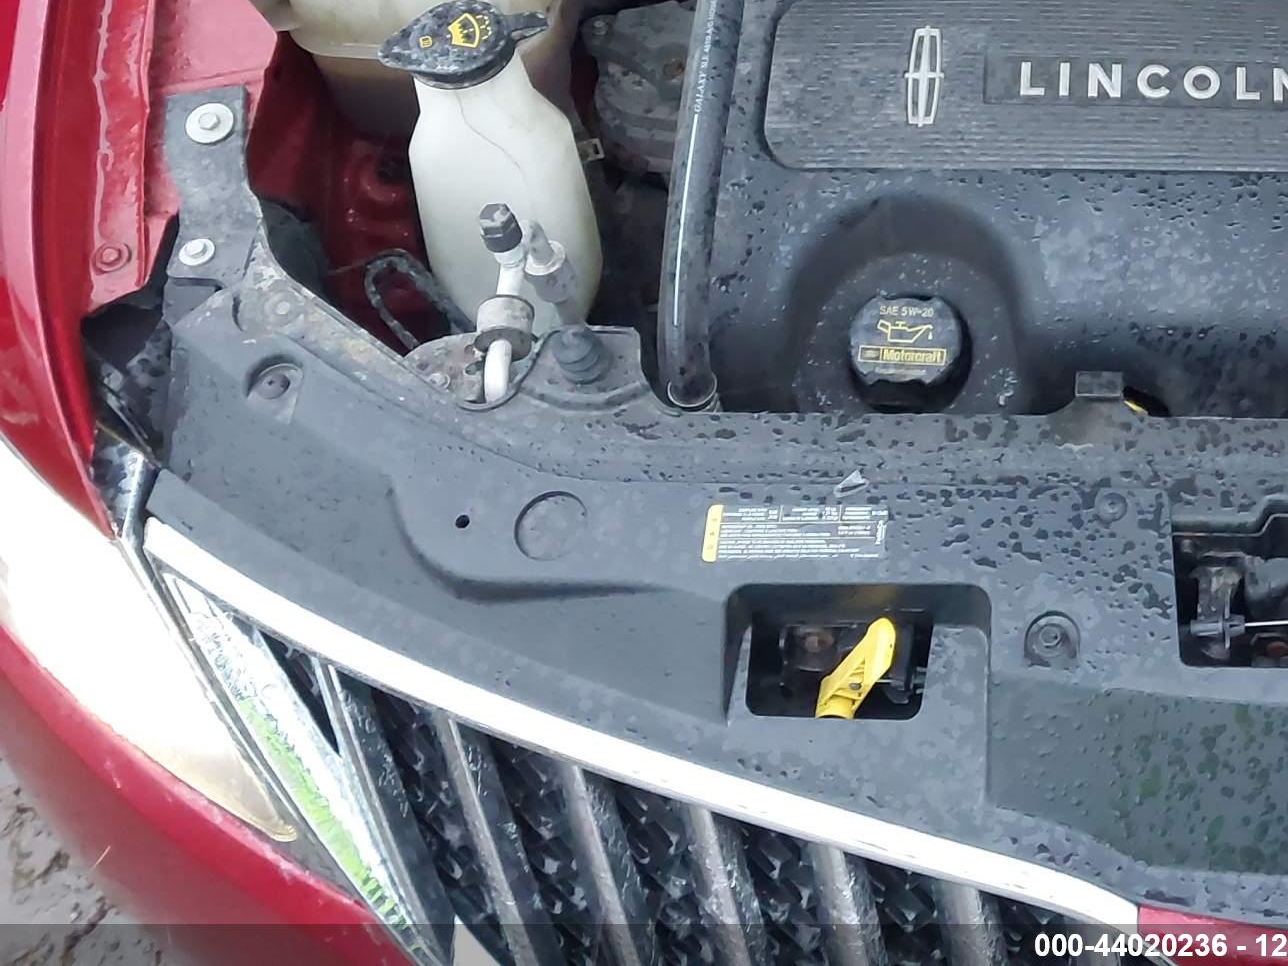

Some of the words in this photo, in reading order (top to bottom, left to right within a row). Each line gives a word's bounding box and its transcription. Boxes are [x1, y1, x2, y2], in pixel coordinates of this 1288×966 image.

[694, 71, 707, 113] GALAXY
[880, 305, 899, 315] SAE
[901, 306, 935, 318] 5W-20
[883, 348, 942, 363] Motorcraft
